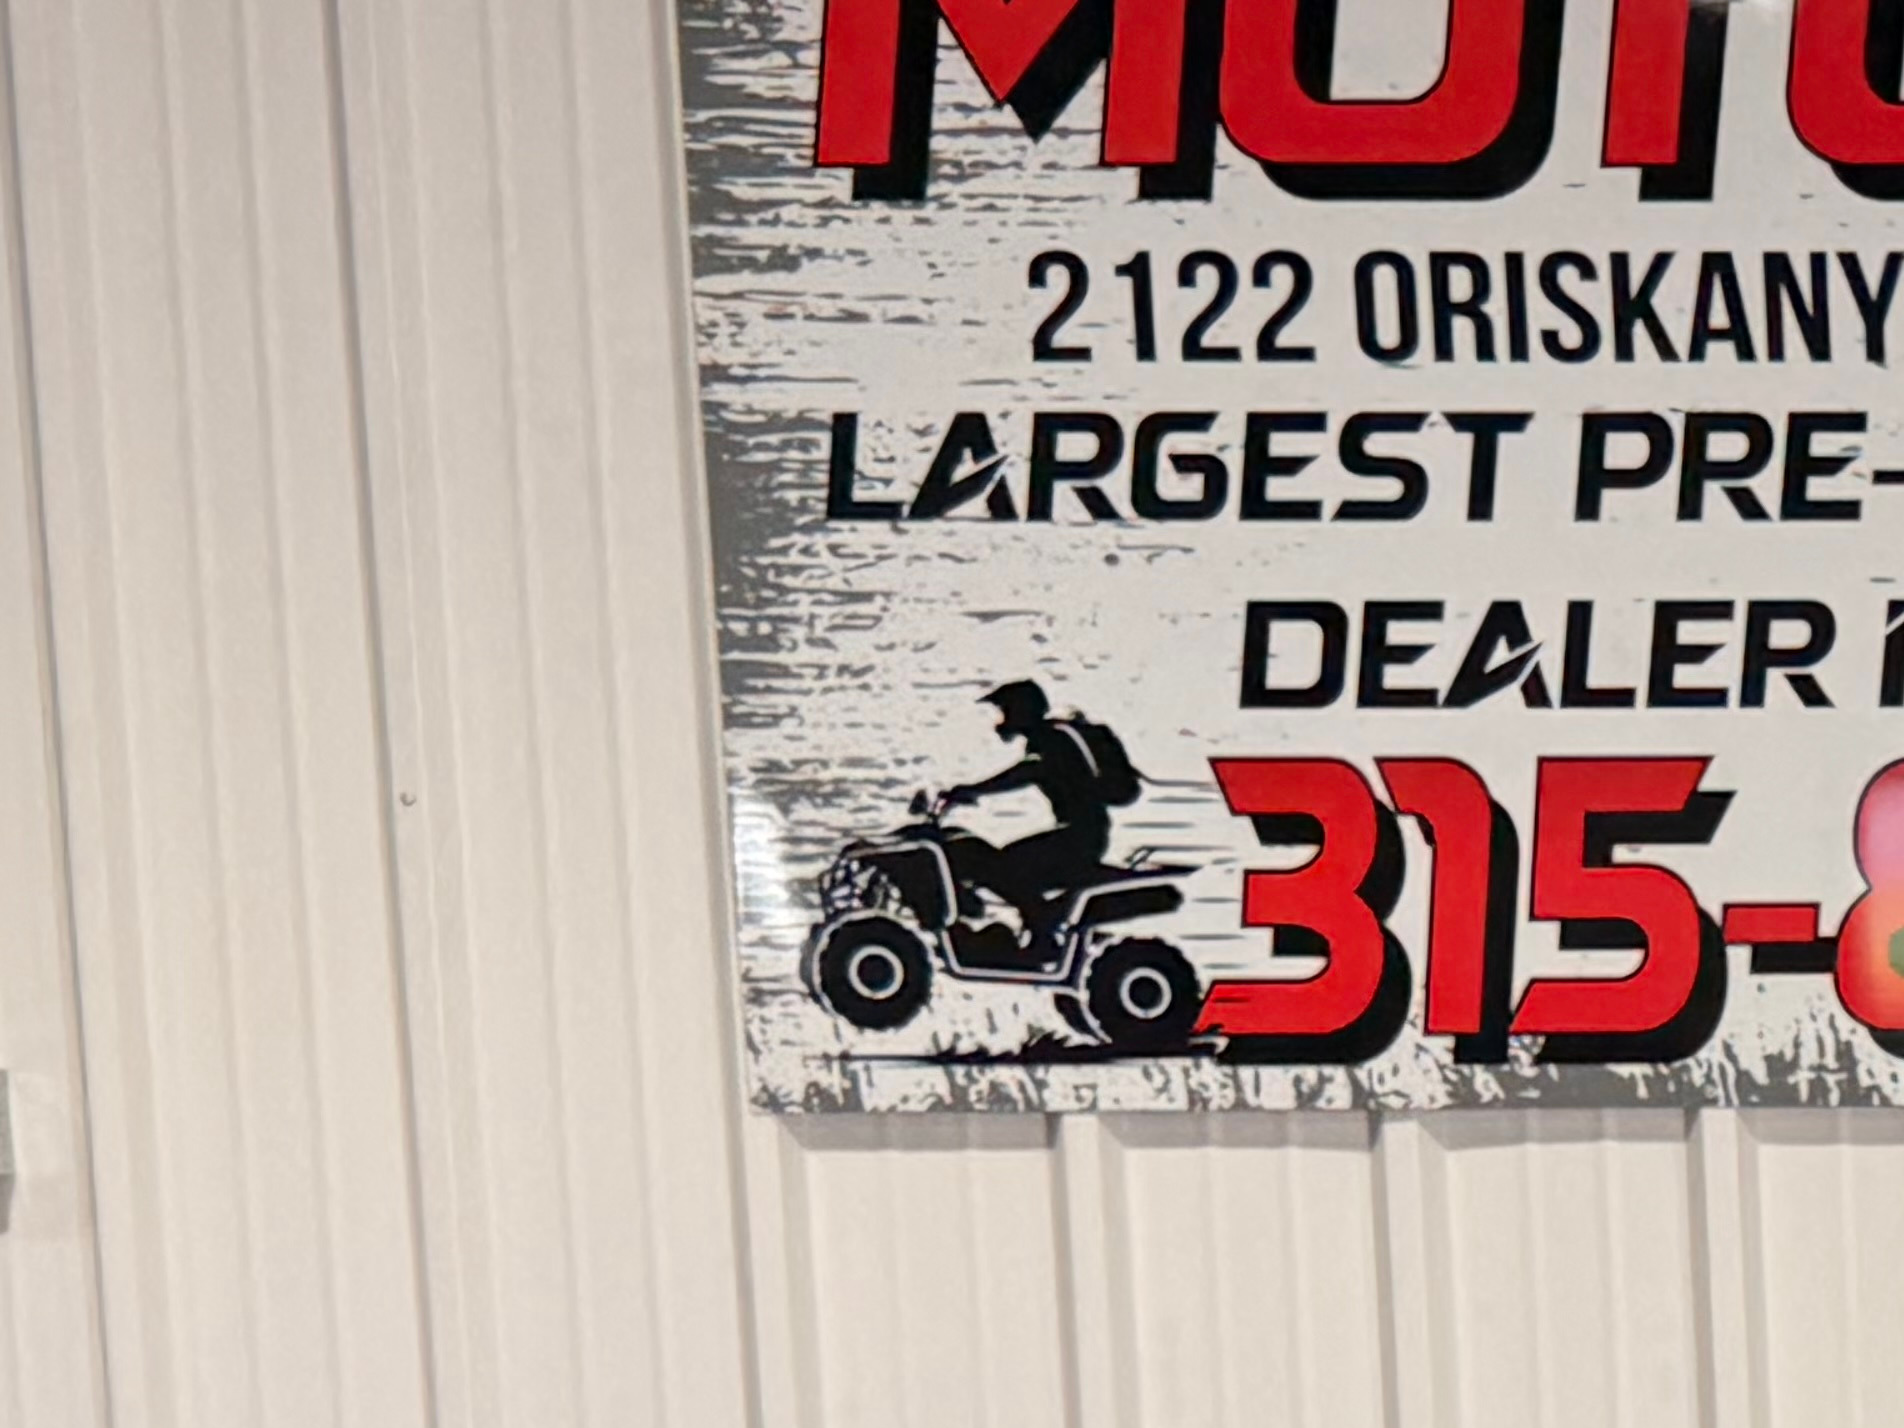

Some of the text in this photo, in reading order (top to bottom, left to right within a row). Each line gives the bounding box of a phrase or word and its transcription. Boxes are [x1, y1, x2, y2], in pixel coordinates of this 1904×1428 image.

[1027, 249, 1317, 363] 2122
[827, 410, 1534, 523] LARGEST
[1239, 599, 1837, 709] DEALER
